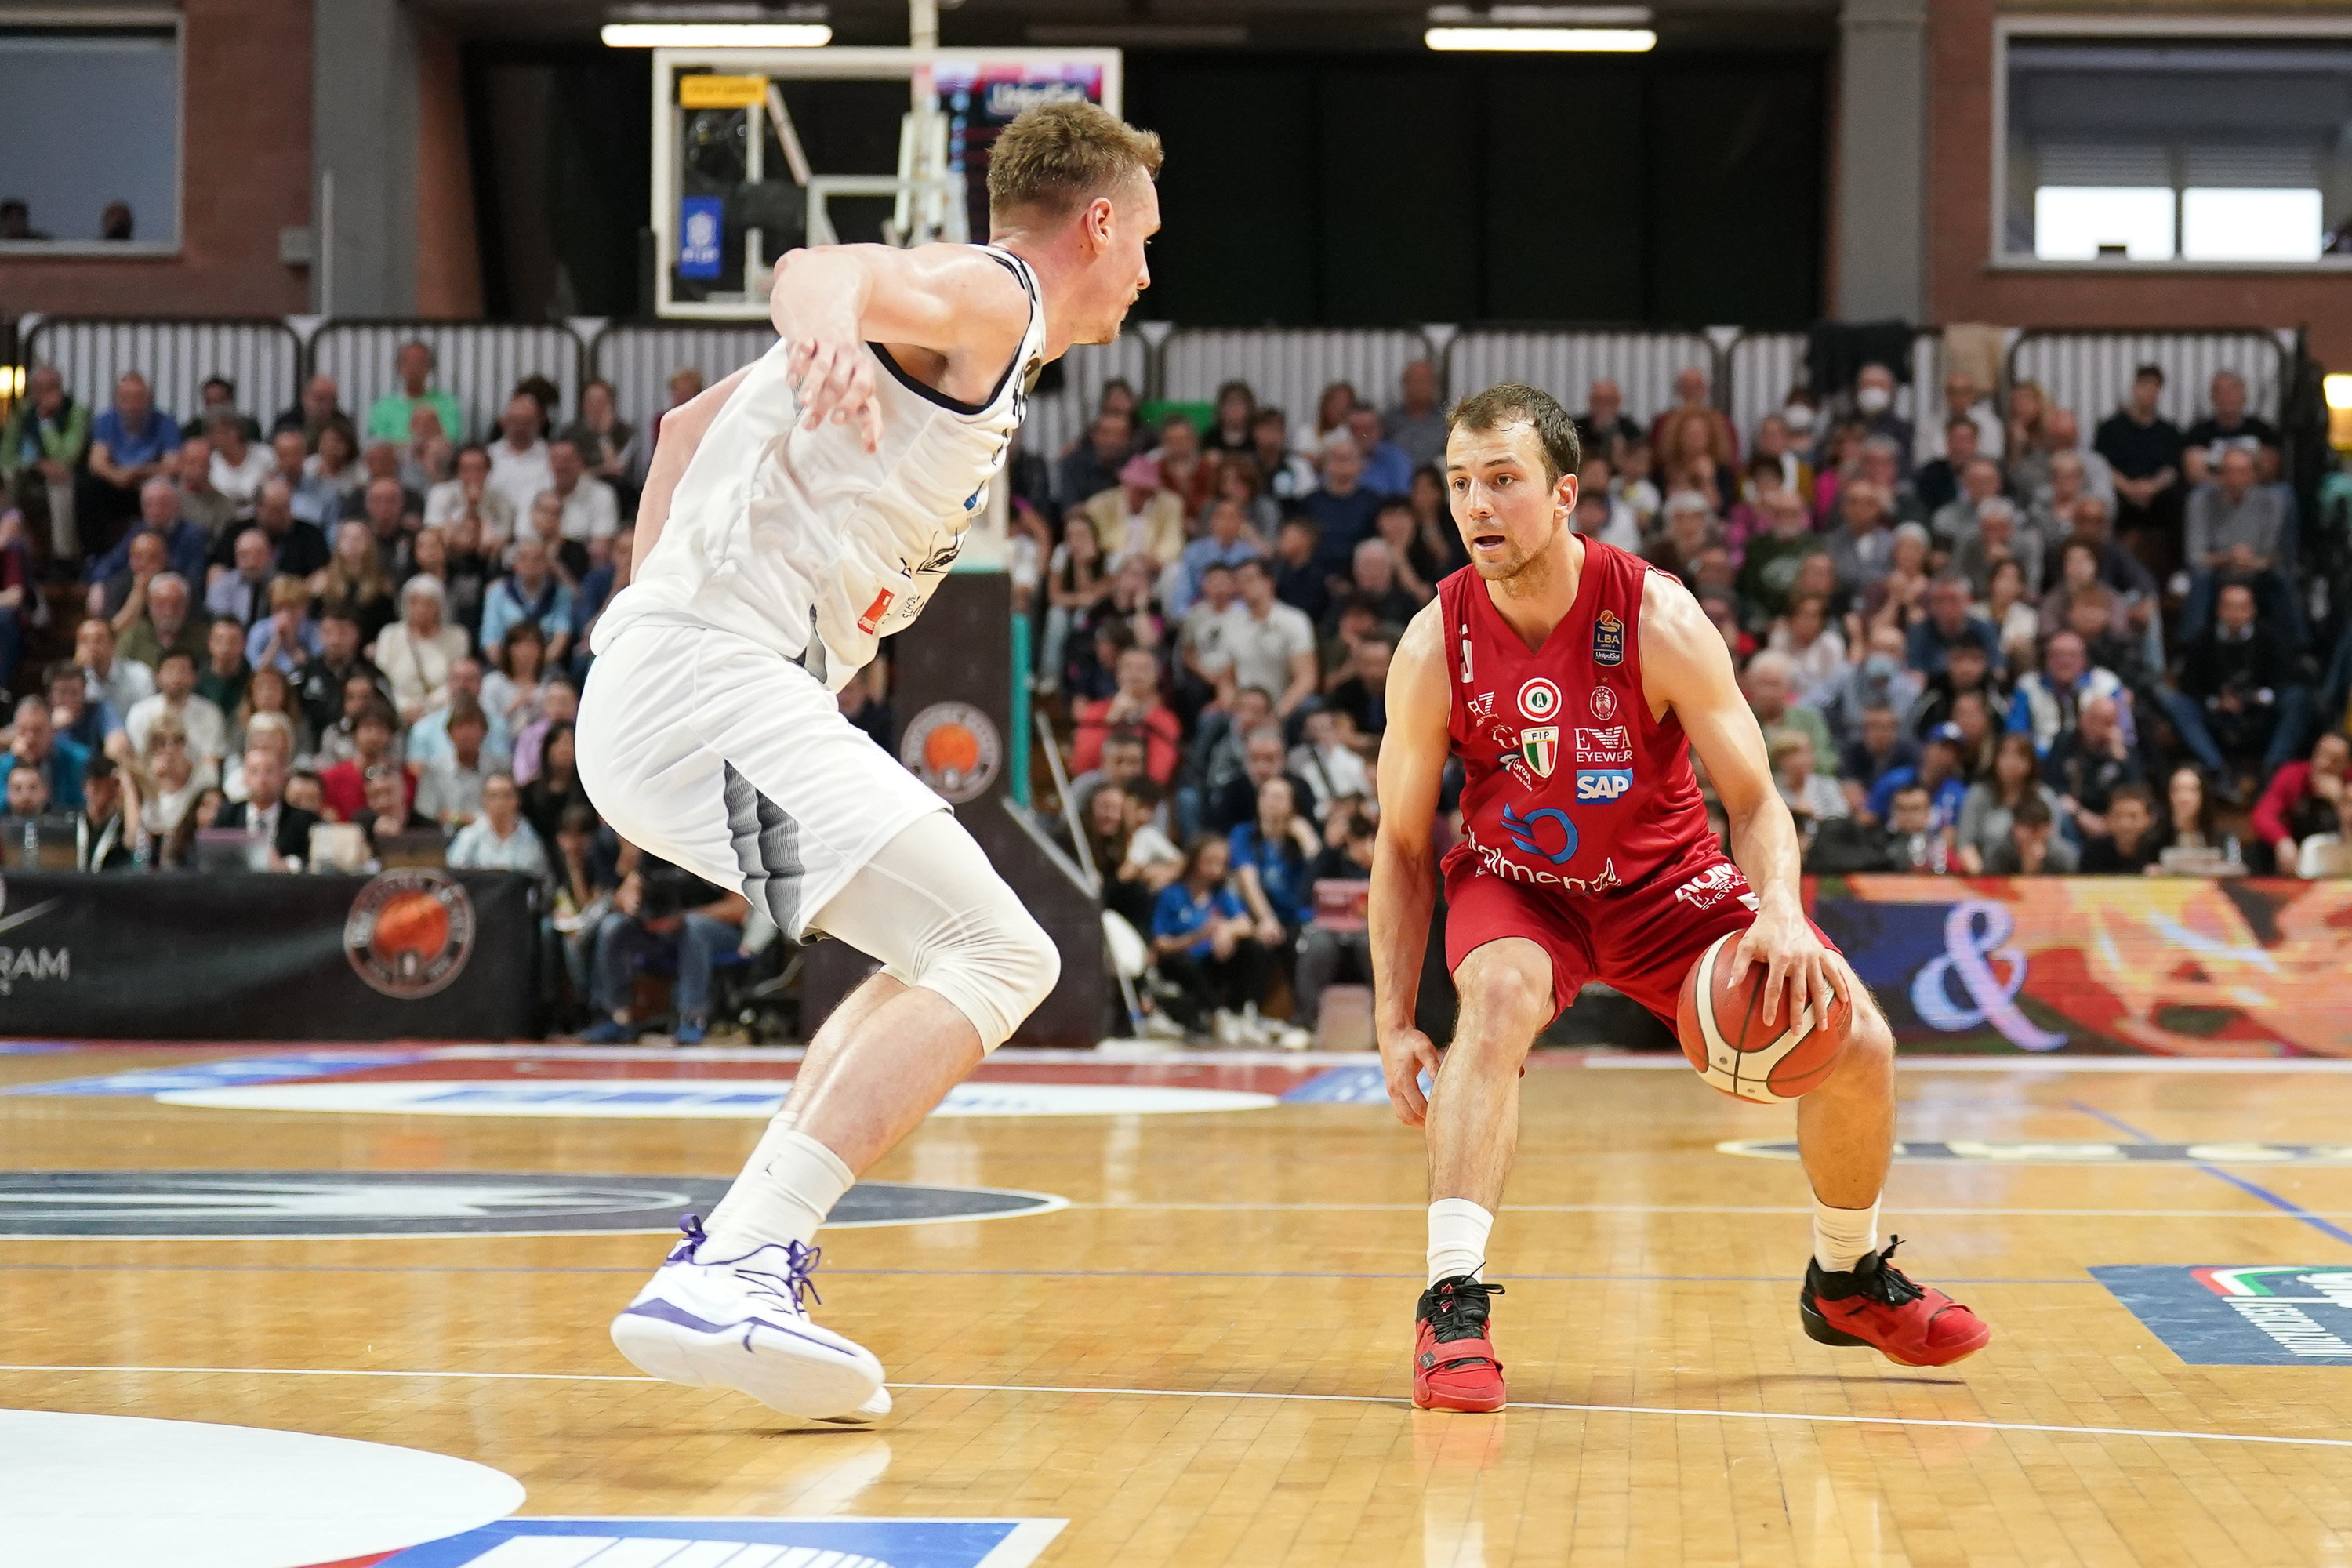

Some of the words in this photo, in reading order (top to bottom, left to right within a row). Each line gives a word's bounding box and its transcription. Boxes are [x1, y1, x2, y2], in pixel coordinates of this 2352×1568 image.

[1597, 633, 1620, 644] LBA
[1531, 731, 1550, 741] FIP
[1577, 775, 1629, 799] SAP
